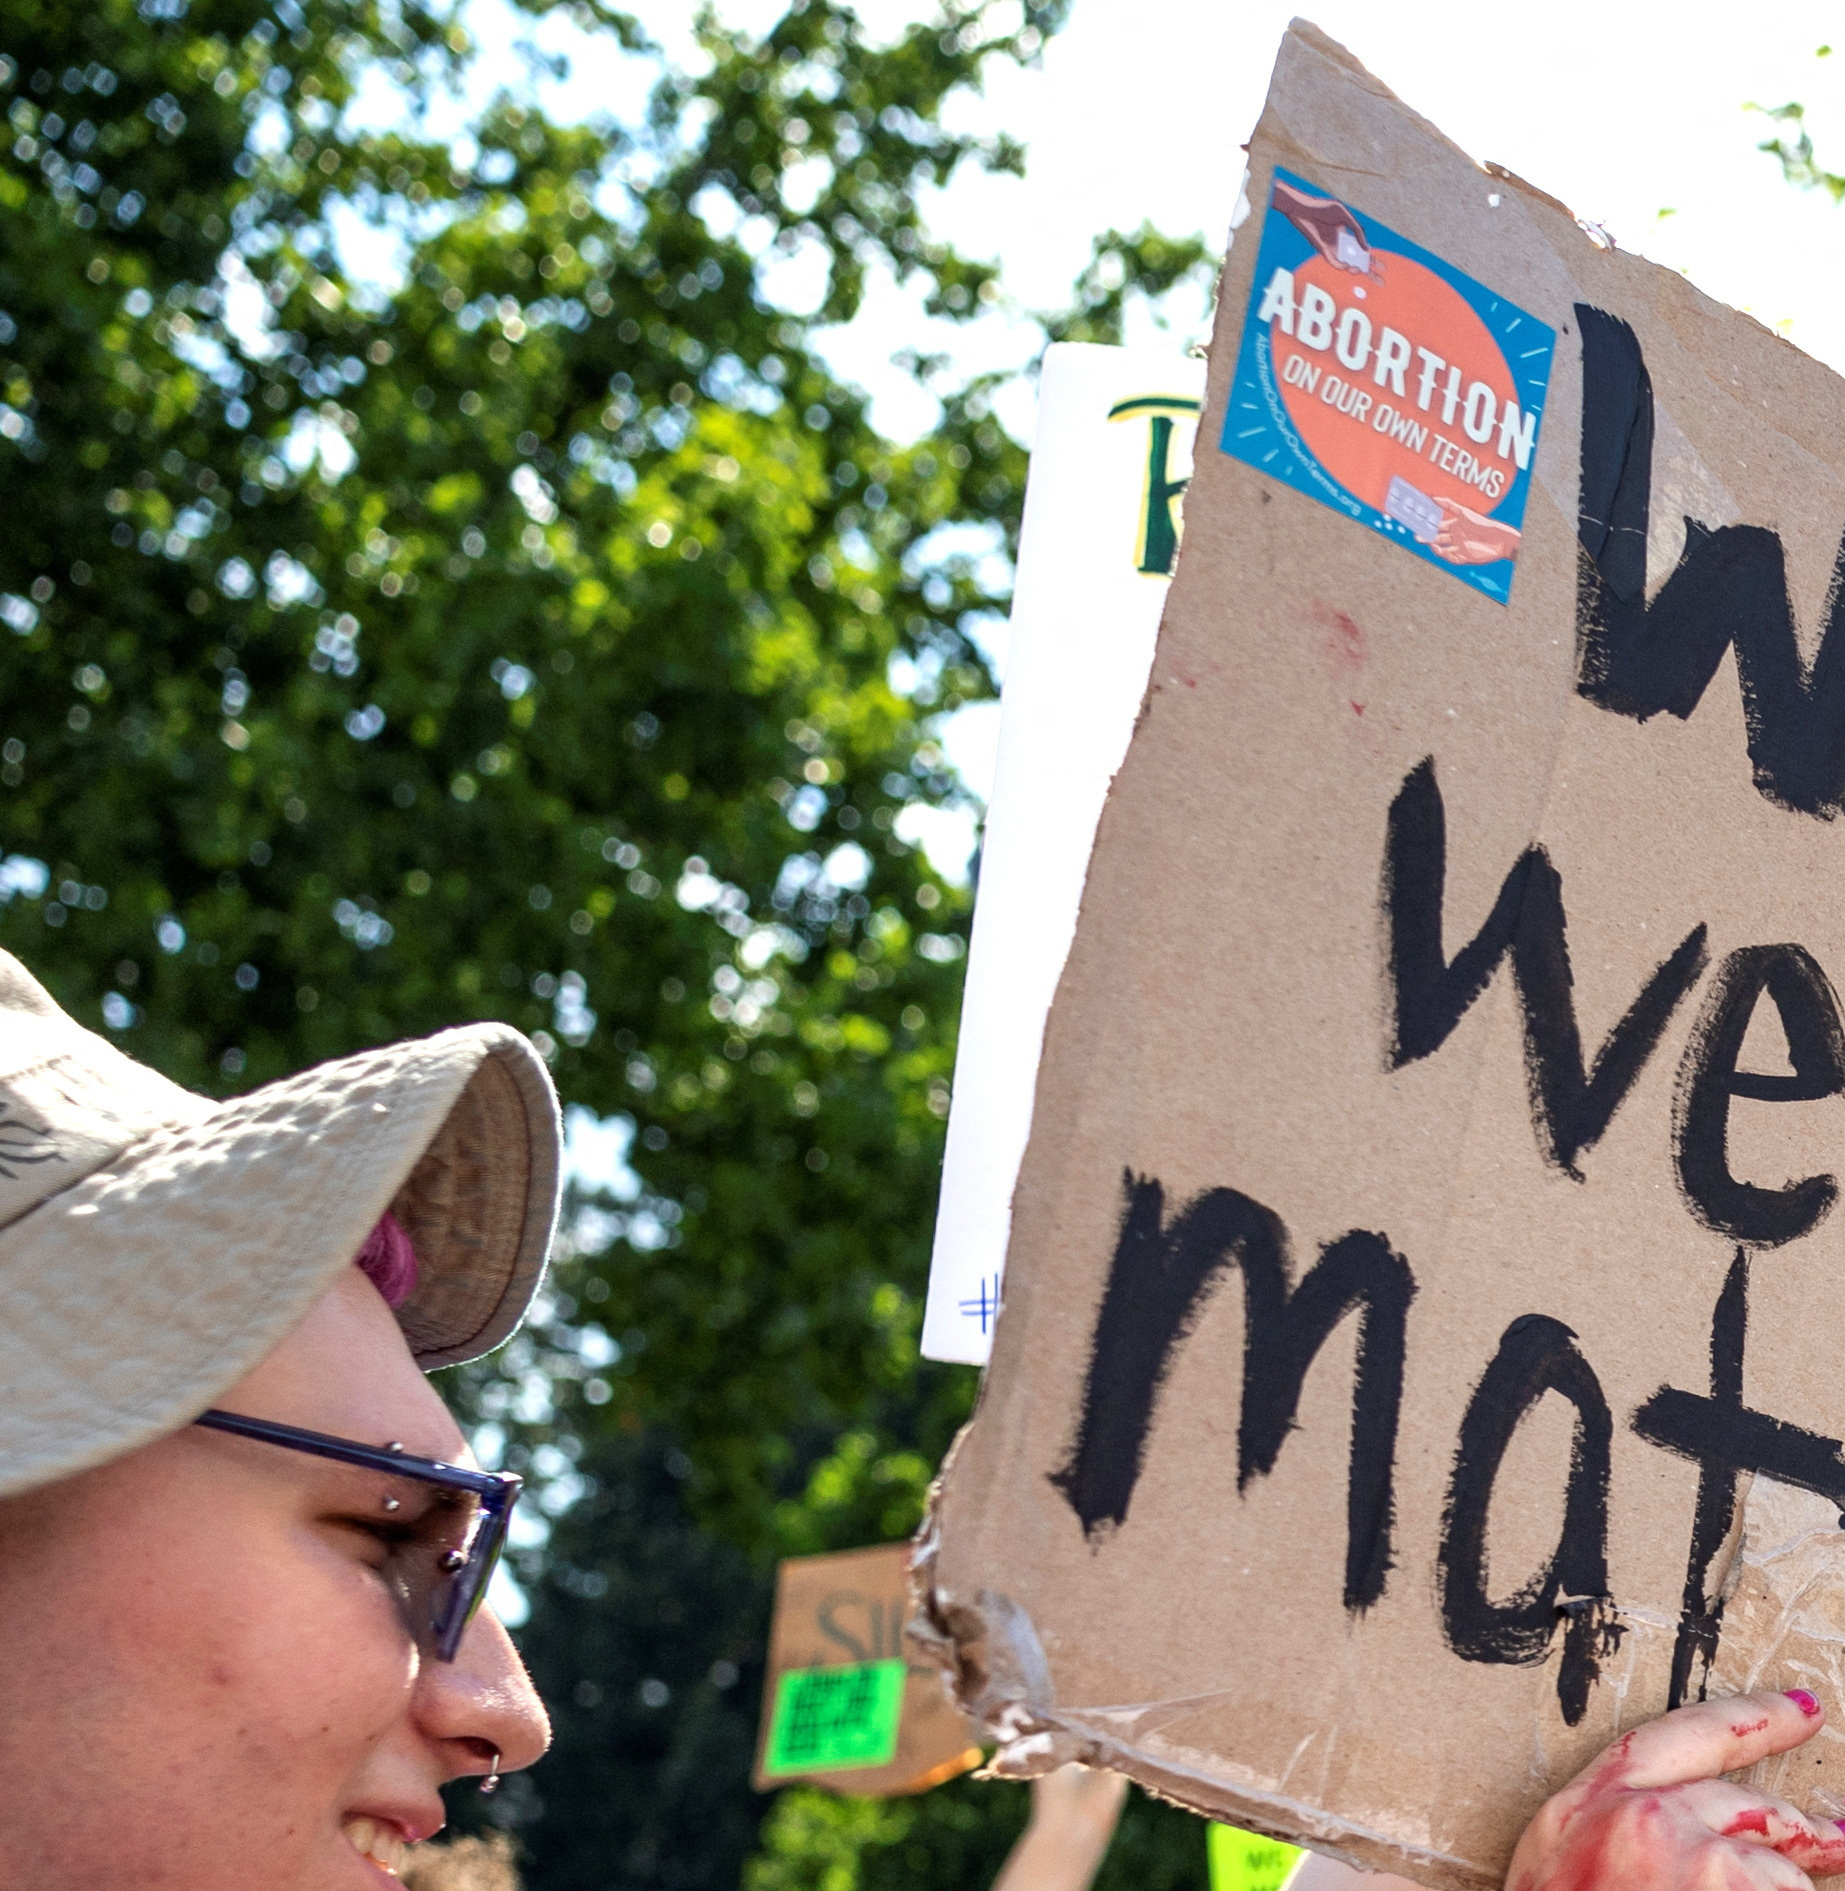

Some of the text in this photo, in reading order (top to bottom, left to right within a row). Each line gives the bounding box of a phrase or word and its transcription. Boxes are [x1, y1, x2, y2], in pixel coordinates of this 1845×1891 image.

[1256, 332, 1362, 516] AbortionOnOurOwnTerms.org
[1257, 267, 1537, 471] ABORTION
[1283, 353, 1508, 500] ON OUR OWN TERMS
